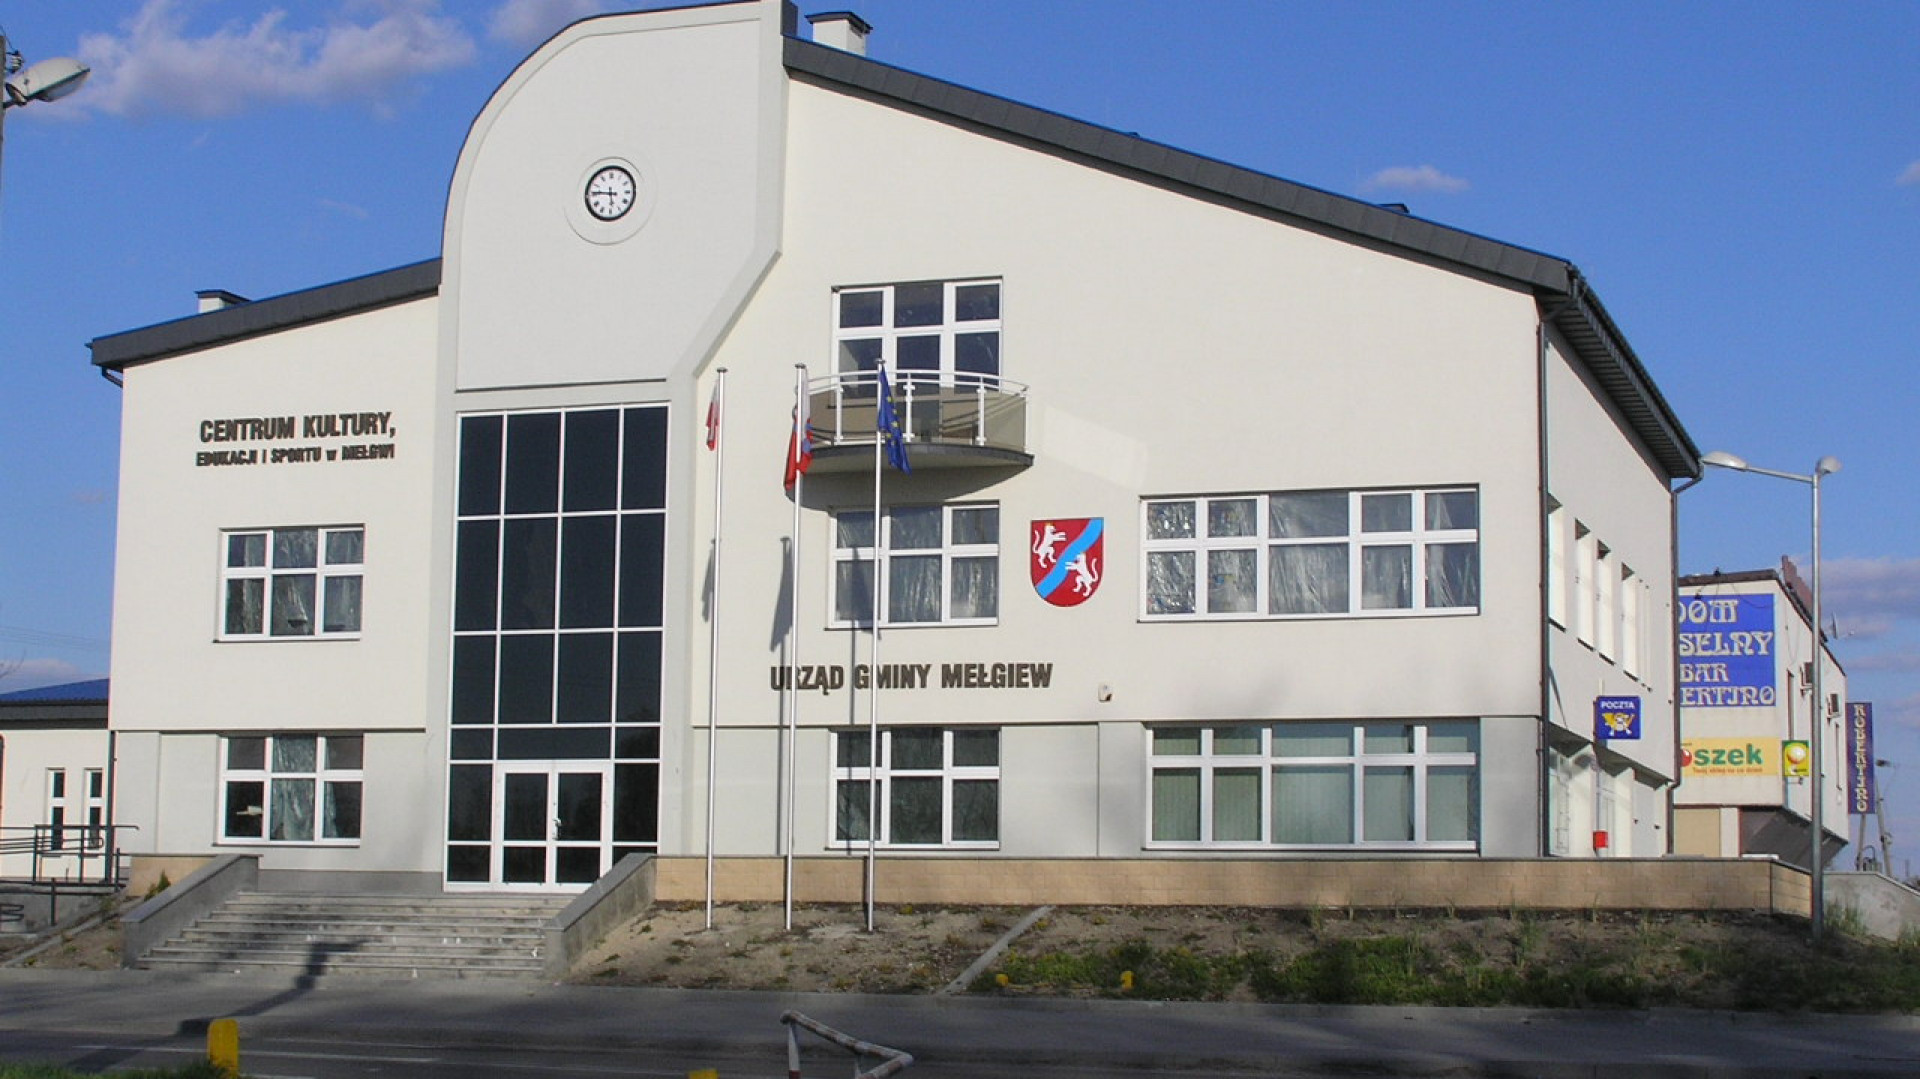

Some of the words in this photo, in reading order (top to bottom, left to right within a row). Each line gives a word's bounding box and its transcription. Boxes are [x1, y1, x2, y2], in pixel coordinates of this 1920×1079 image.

[200, 416, 295, 443] CENTRUM
[302, 411, 396, 438] KULTURY,
[196, 449, 257, 467] EDUKACJI
[262, 450, 267, 463] I
[271, 447, 321, 463] SPORTU
[341, 443, 395, 461] MEŁGWI
[770, 664, 844, 696] URZĄD
[854, 663, 931, 689] GMINY
[941, 663, 1053, 689] MEŁGIEW
[1679, 663, 1729, 682] BAR
[1601, 700, 1636, 710] POCZTA
